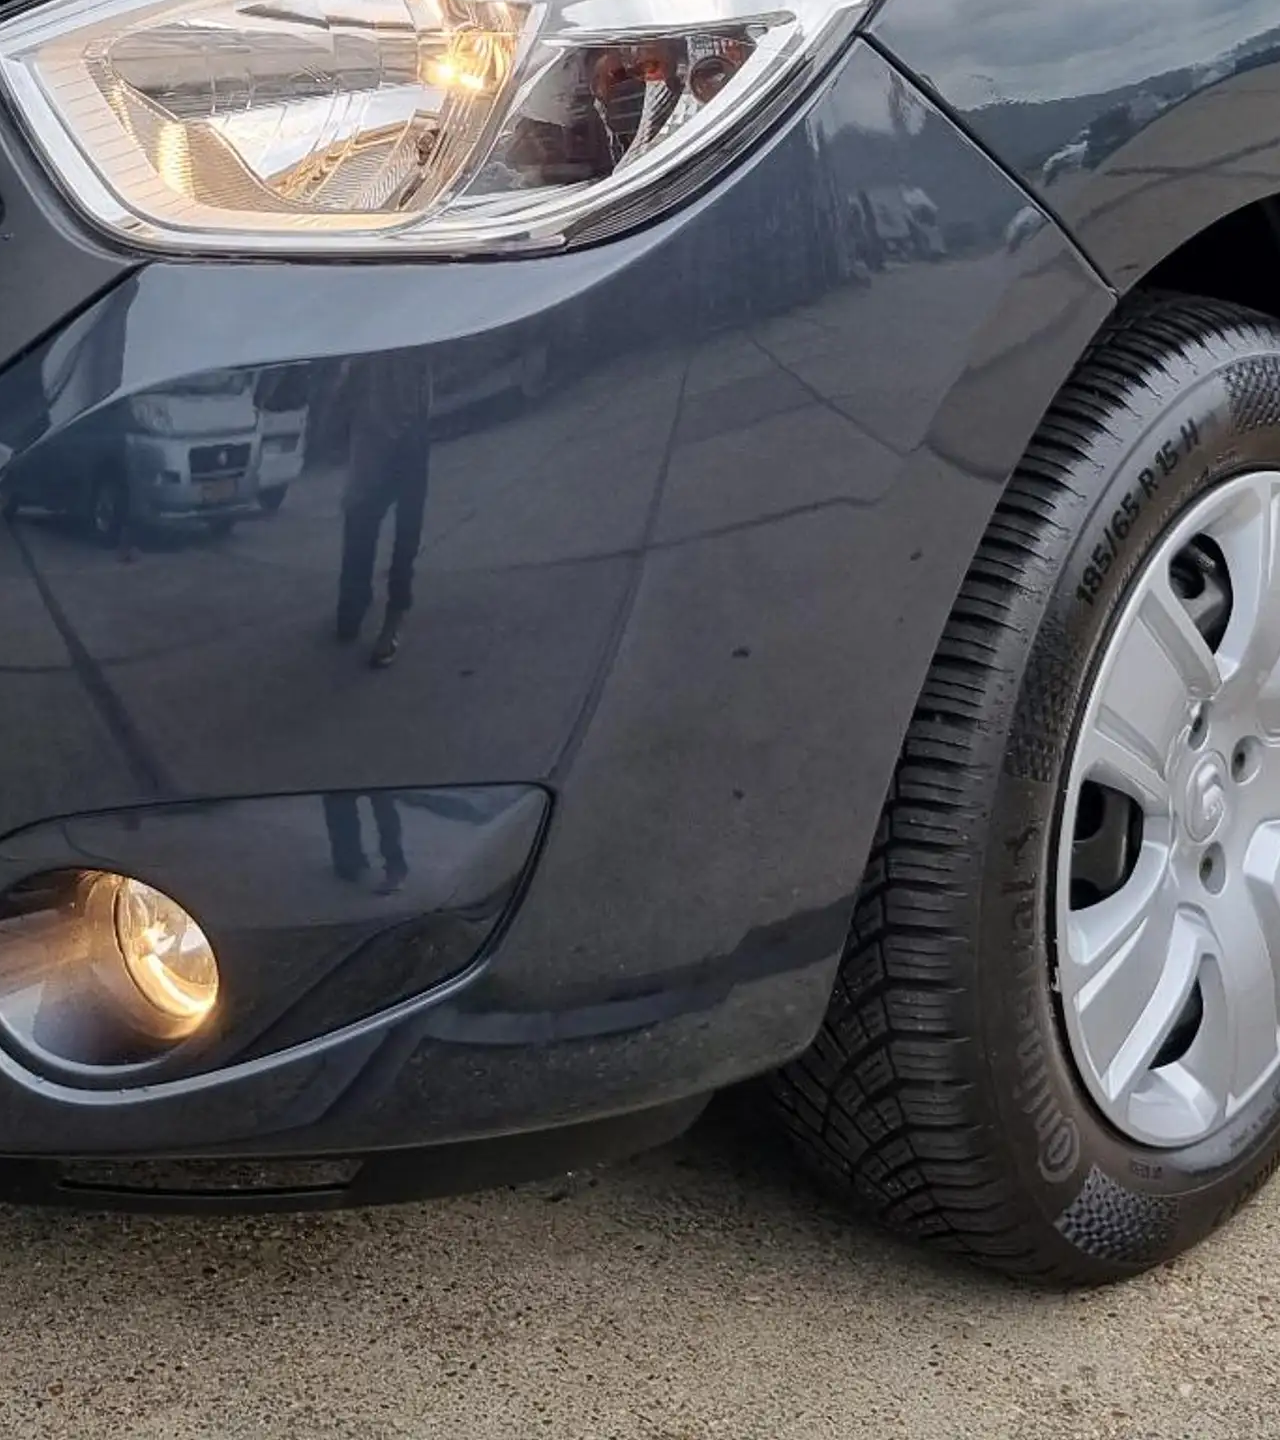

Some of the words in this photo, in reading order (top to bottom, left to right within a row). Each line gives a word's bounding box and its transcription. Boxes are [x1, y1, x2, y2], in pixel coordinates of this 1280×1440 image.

[1075, 492, 1141, 607] 185/65
[1137, 466, 1160, 501] R
[1154, 439, 1180, 477] 15
[1179, 417, 1202, 454] H
